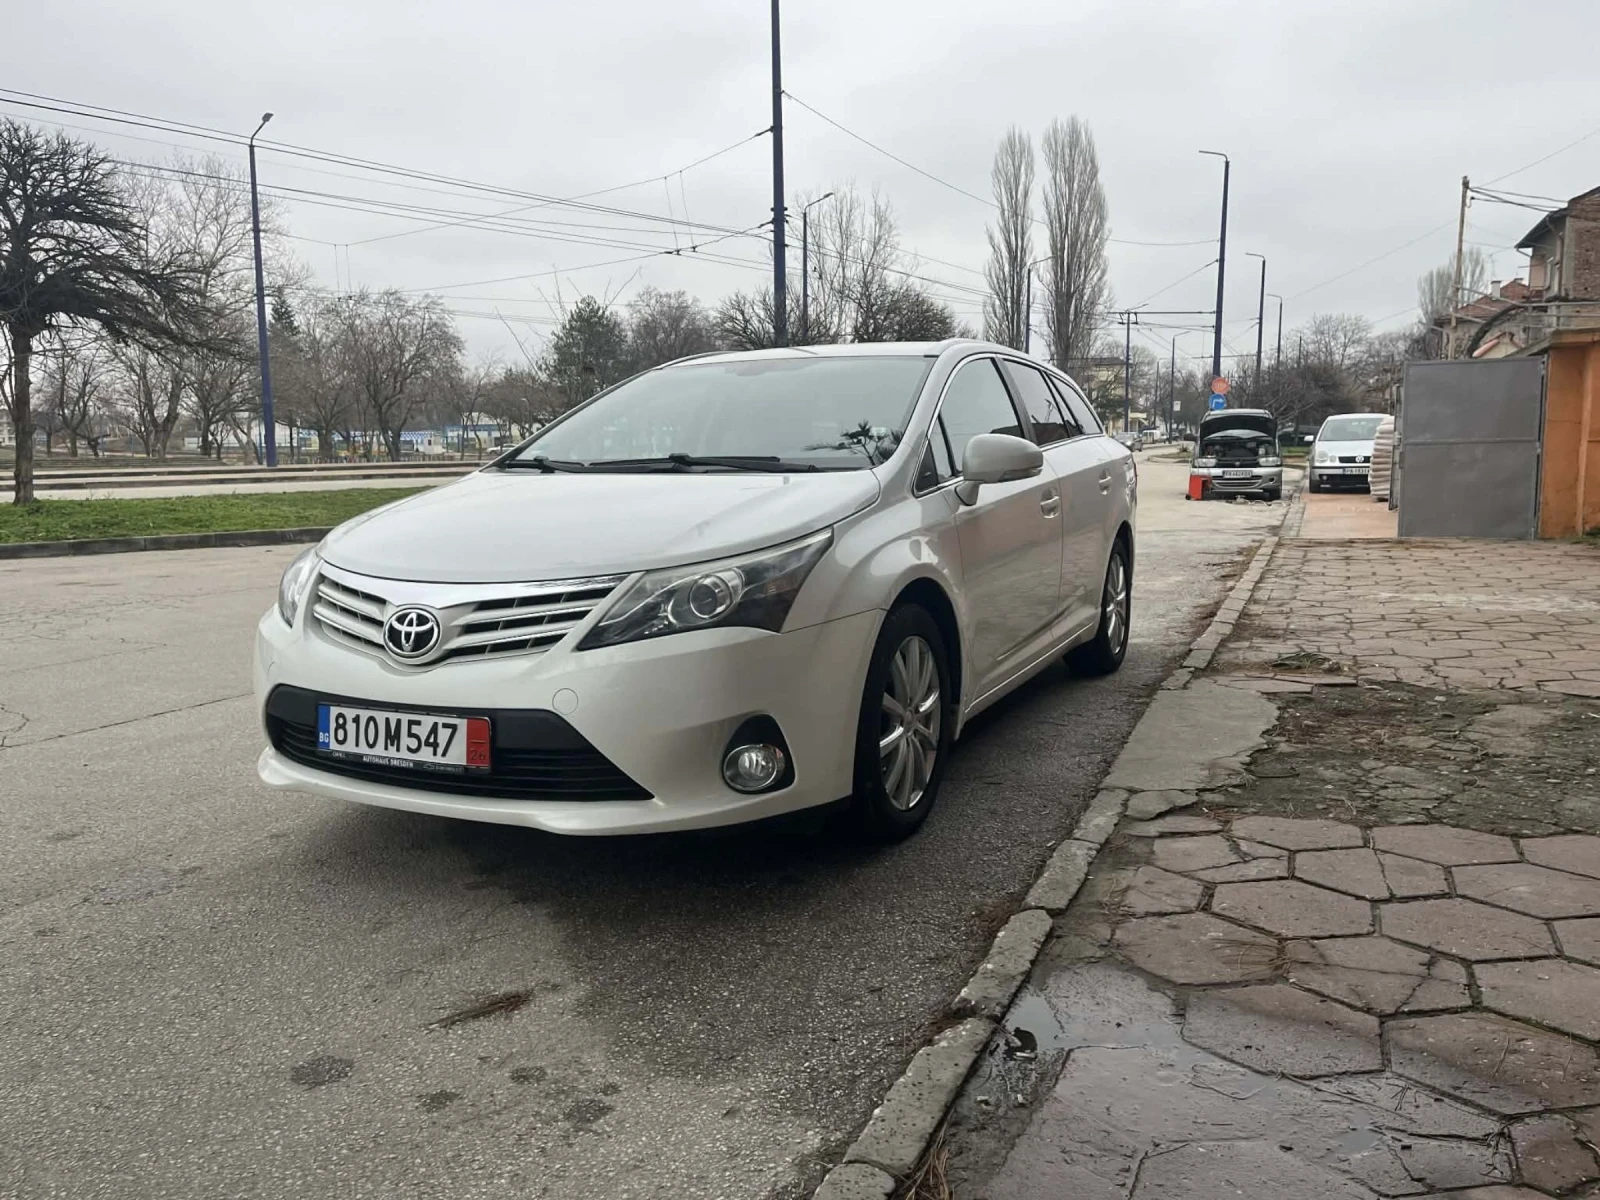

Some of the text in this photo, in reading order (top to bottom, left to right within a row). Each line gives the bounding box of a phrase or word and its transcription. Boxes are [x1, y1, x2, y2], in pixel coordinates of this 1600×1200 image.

[319, 731, 329, 743] BG
[333, 711, 458, 758] 810M547
[362, 755, 414, 769] AUTOHAUS DRESDEN
